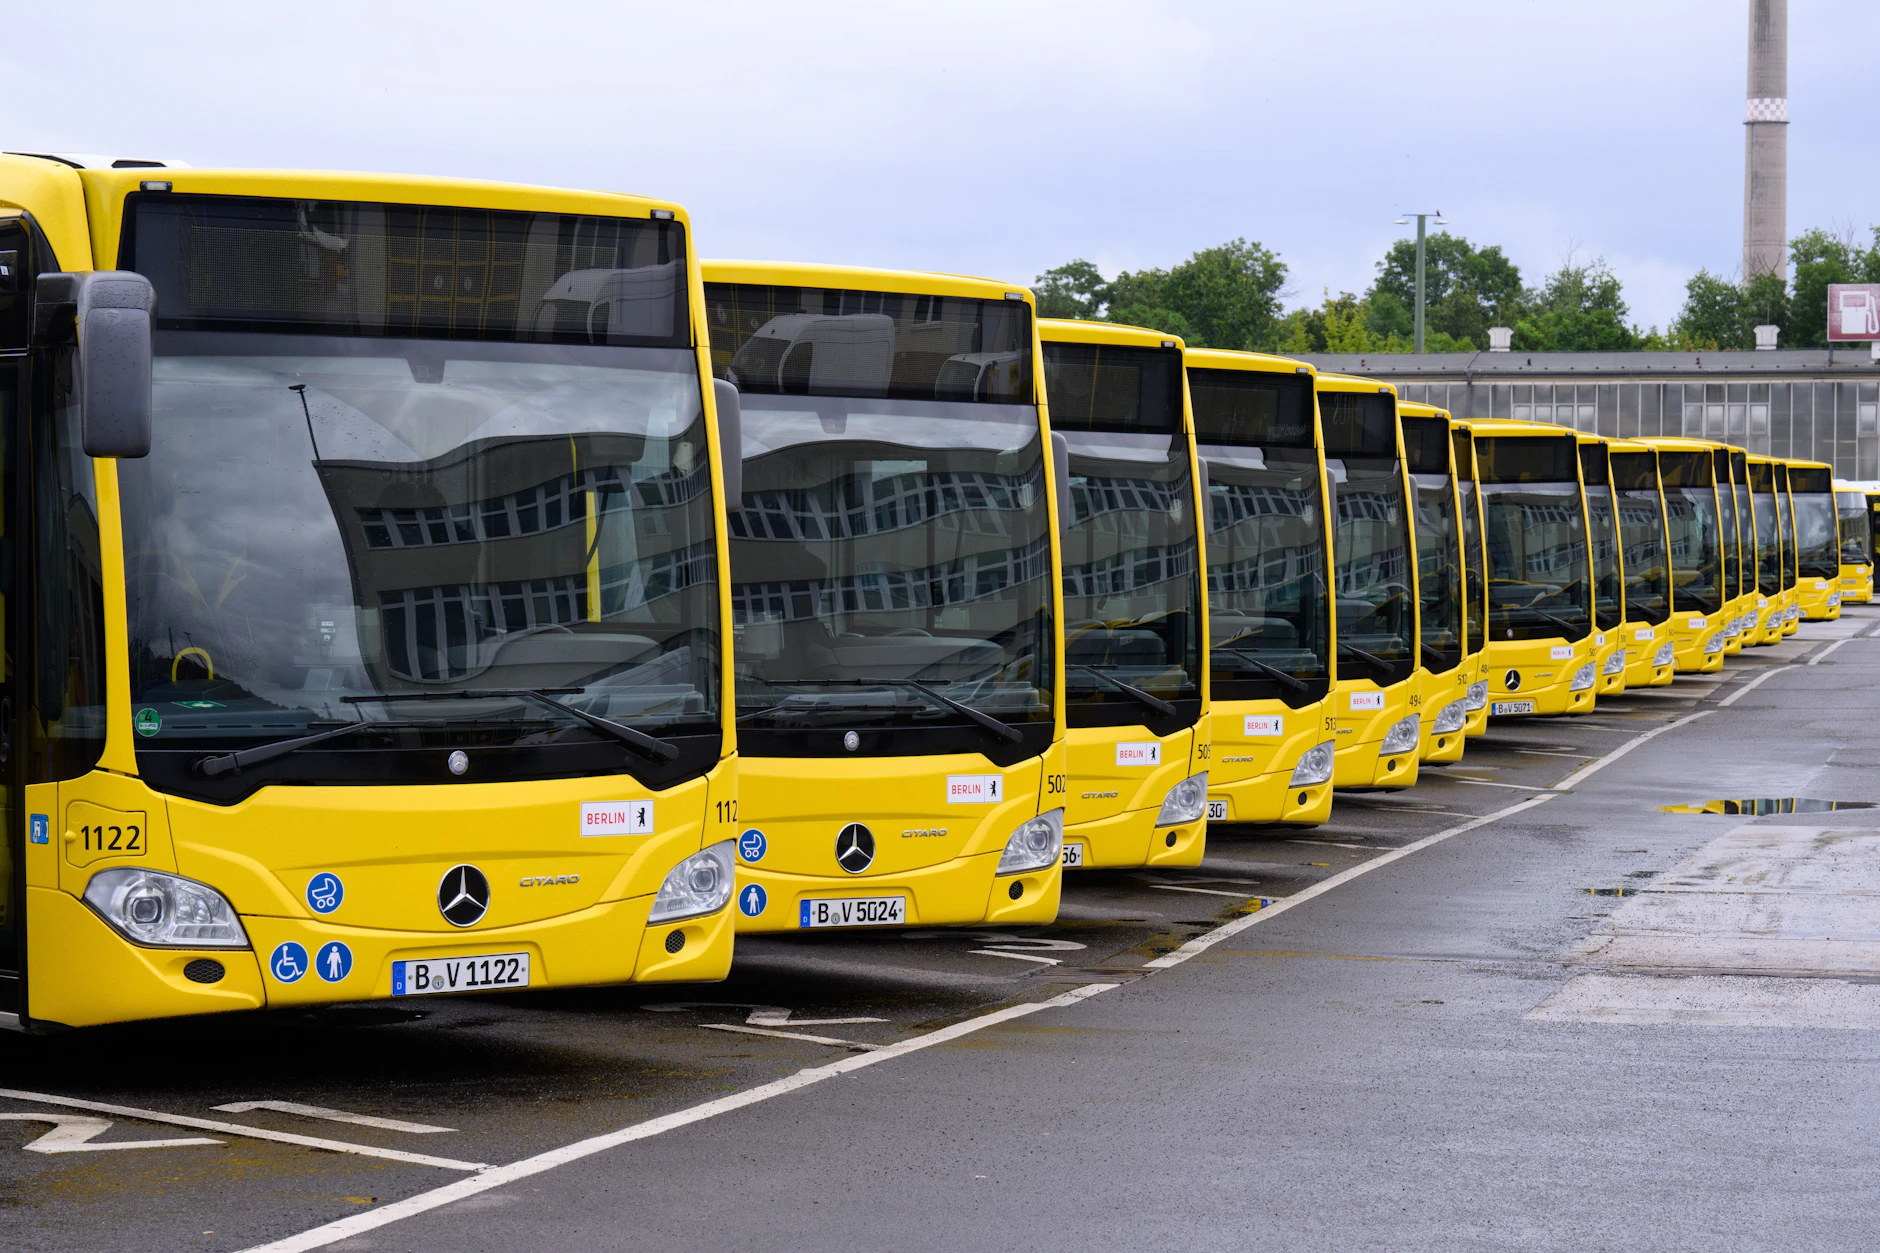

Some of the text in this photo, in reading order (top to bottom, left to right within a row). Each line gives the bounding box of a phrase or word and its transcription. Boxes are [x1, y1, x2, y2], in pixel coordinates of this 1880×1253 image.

[1353, 697, 1372, 705] BERLIN
[1498, 702, 1504, 714] B
[1507, 702, 1513, 713] V
[1247, 722, 1269, 730] BERLIN
[1119, 750, 1144, 759] BERLIN
[951, 784, 981, 795] BERLIN
[1048, 774, 1066, 794] 502
[1081, 790, 1119, 799] CITARO
[587, 811, 626, 825] BERLIN
[716, 800, 738, 824] 112
[81, 825, 141, 850] 1122
[901, 828, 949, 838] CITARO
[519, 873, 581, 888] CITARO
[818, 902, 829, 924] B
[841, 901, 853, 923] V
[857, 900, 898, 922] 5024
[396, 958, 520, 990] D B V 1122
